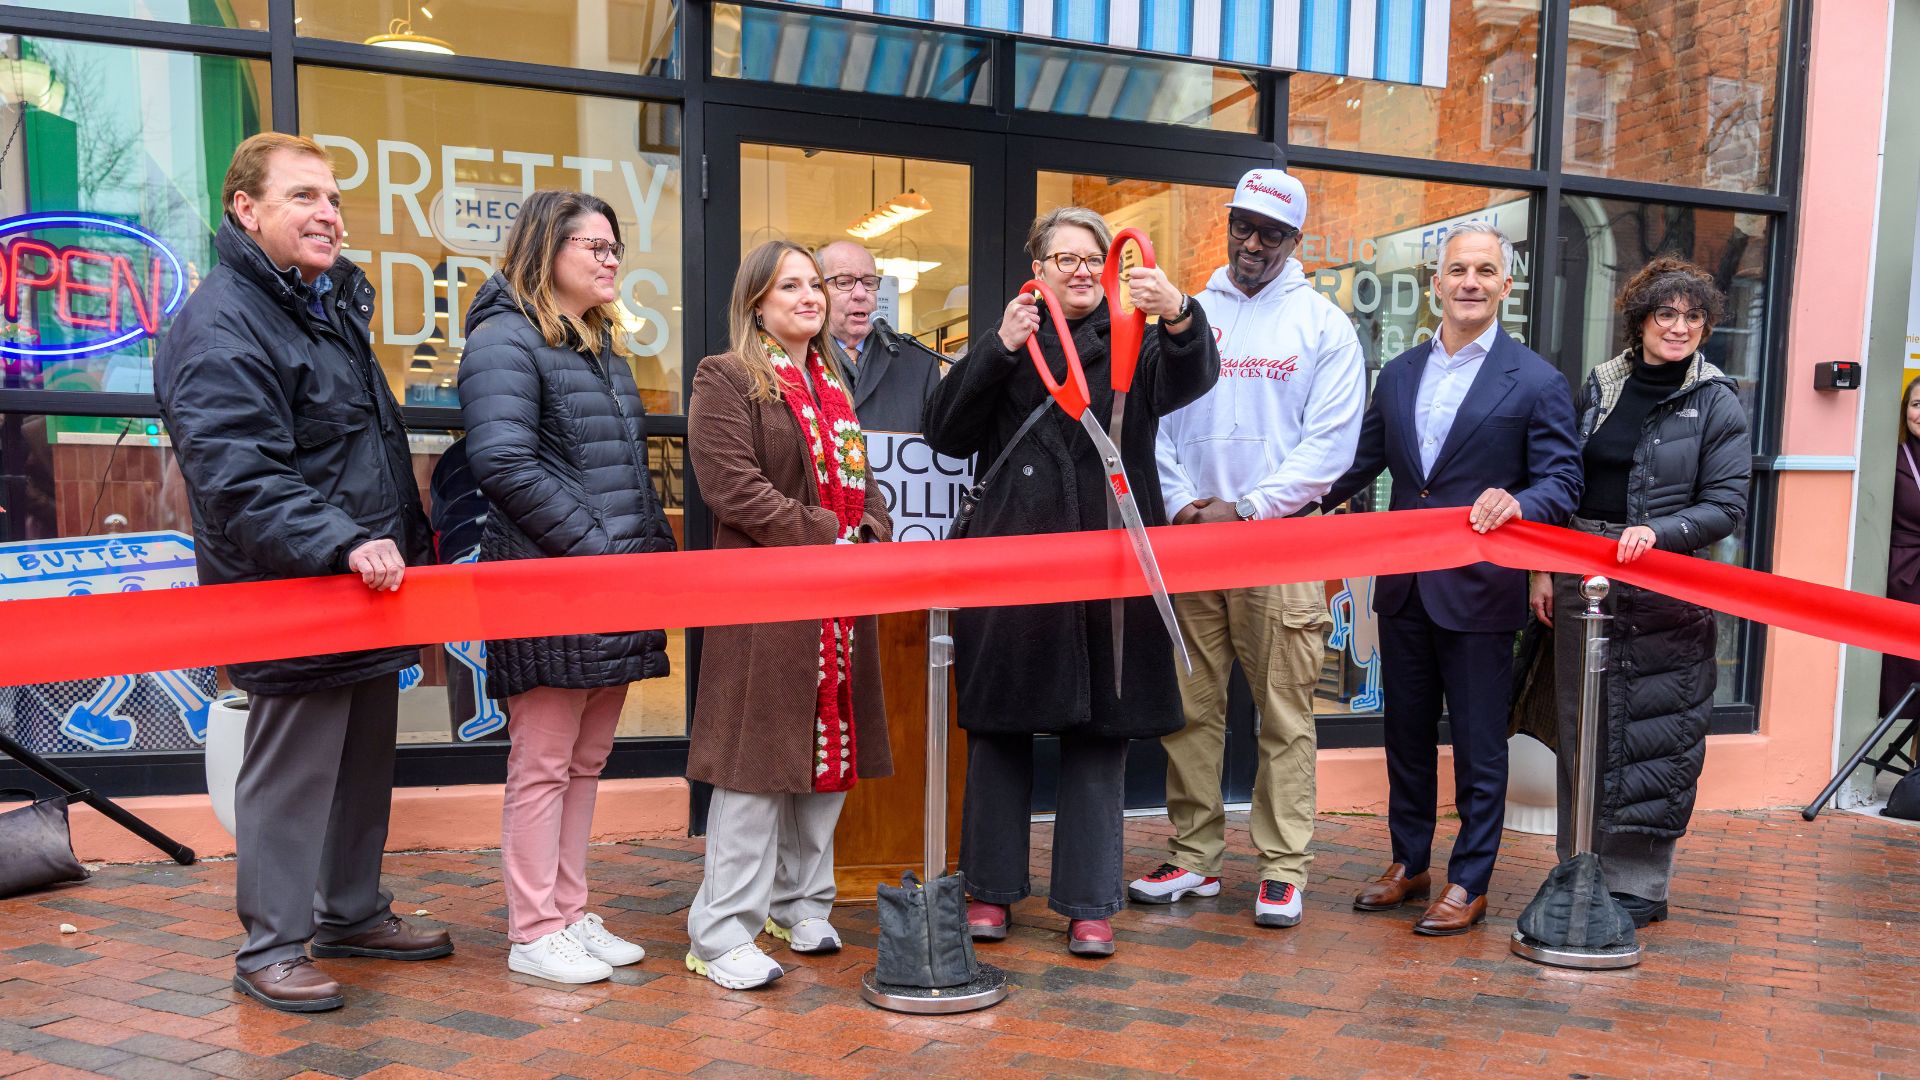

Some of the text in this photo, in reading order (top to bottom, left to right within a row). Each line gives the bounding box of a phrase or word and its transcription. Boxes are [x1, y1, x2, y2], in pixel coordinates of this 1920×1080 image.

[1243, 180, 1292, 204] Professionals
[0, 242, 161, 334] PEN
[1266, 368, 1291, 382] LLC
[17, 544, 149, 571] BUTTER
